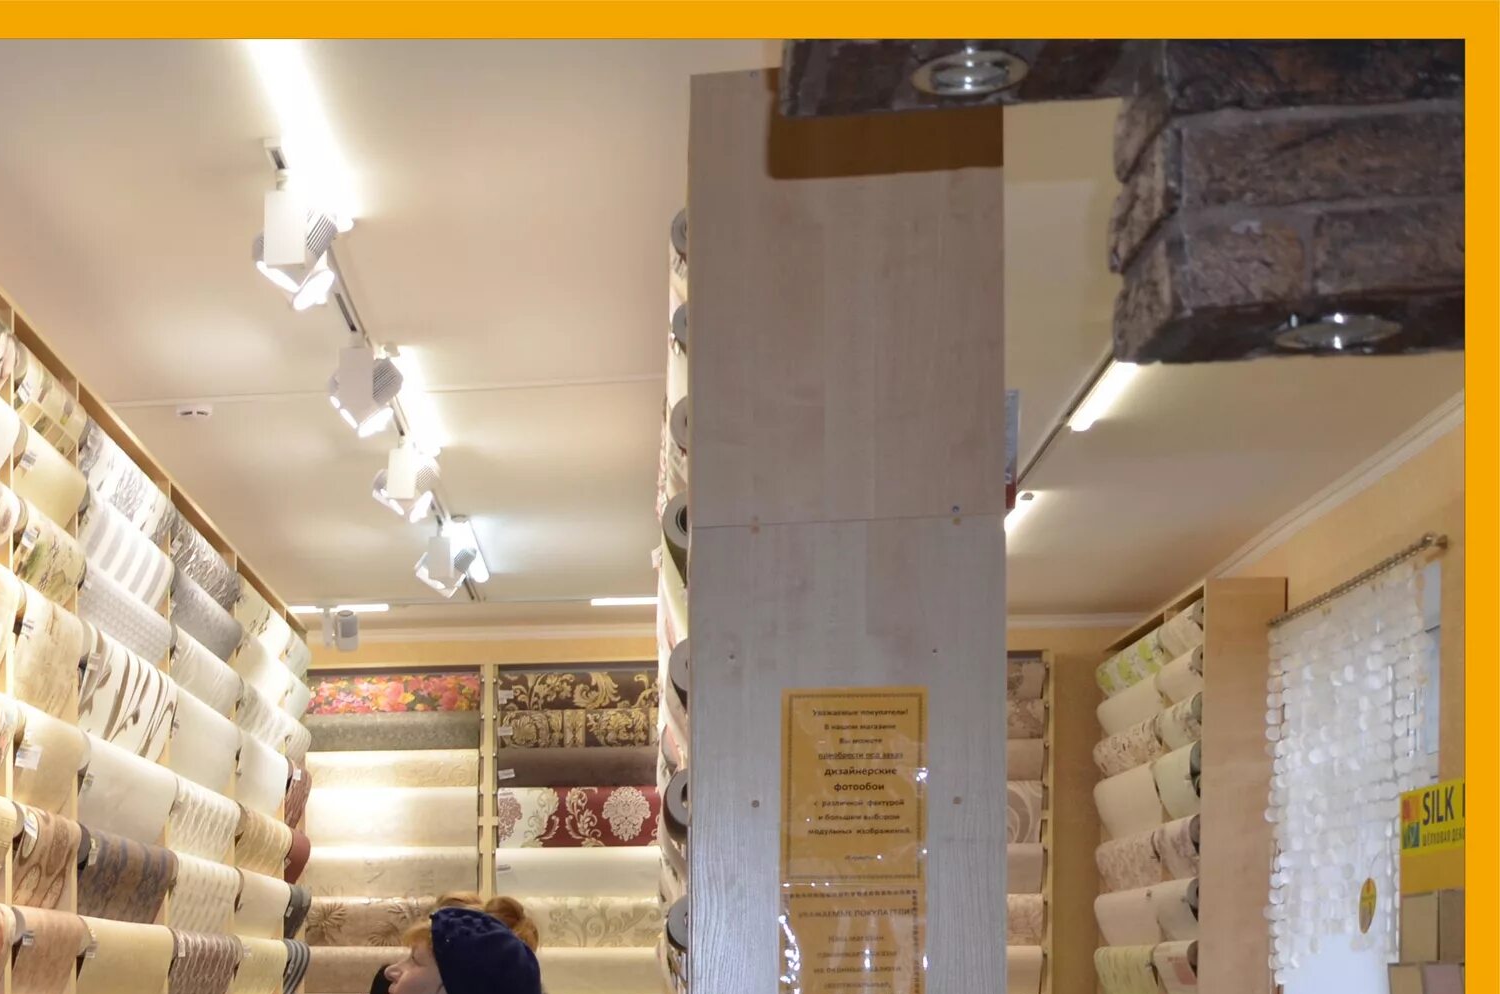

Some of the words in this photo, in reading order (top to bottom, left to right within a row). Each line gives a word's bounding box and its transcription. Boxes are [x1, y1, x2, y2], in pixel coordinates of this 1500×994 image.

[824, 766, 898, 778] дизайнерские
[833, 781, 885, 792] фотообои
[1422, 785, 1455, 826] SILK
